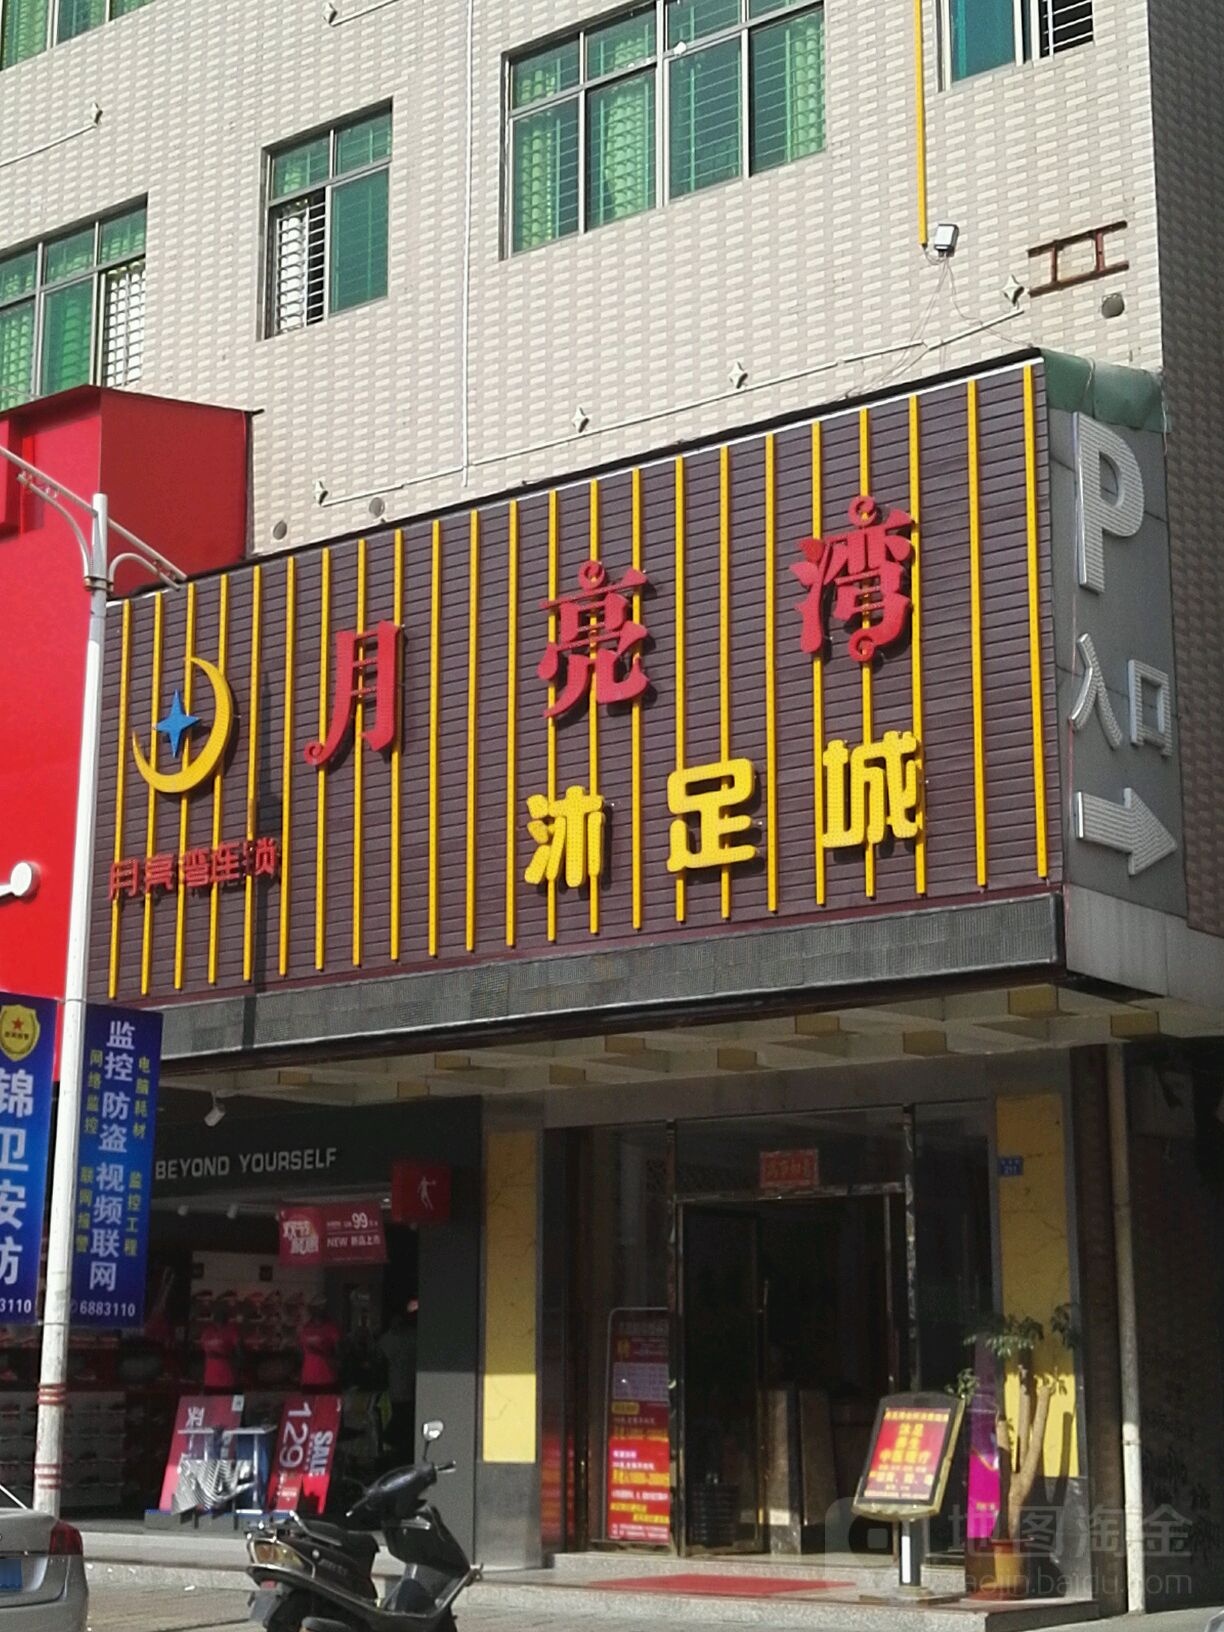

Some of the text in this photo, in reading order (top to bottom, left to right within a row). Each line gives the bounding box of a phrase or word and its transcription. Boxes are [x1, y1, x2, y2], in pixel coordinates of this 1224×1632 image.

[1073, 411, 1145, 593] P
[303, 495, 916, 767] 月亮湾
[1069, 634, 1172, 758] 入口
[524, 731, 921, 888] 沐足城
[90, 1020, 136, 1292] 监控防盗视频联网
[155, 1148, 337, 1180] BEYOND YOURSELF
[79, 1300, 136, 1318] 6883110
[279, 1402, 313, 1469] 129
[308, 1430, 334, 1478] SALE
